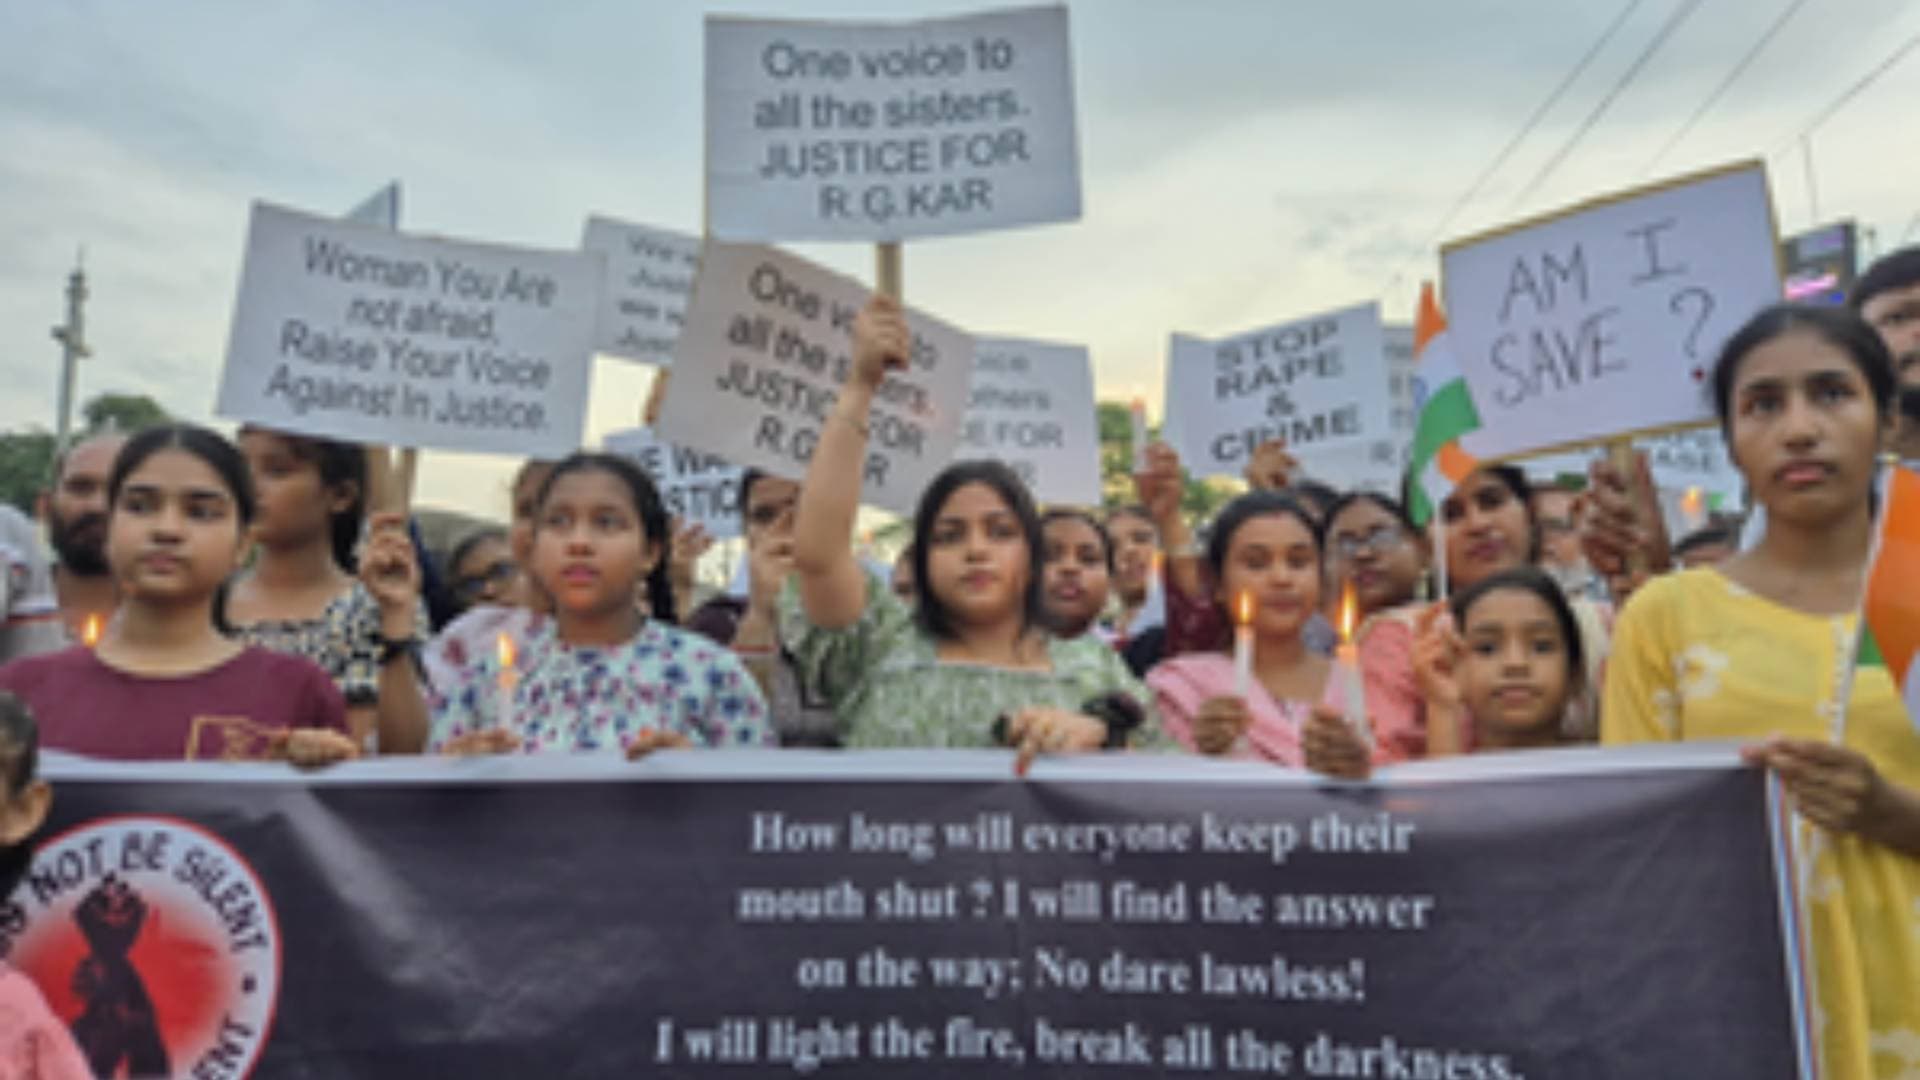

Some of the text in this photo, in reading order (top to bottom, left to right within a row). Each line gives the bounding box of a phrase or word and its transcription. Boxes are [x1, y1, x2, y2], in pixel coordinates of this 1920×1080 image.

[762, 36, 1014, 80] One voice to
[754, 87, 1031, 130] all the sisters.
[759, 127, 1031, 179] JUSTICE FOR
[305, 235, 558, 307] Woman You Are
[749, 262, 822, 322] One
[1498, 216, 1688, 326] AM I
[347, 295, 402, 328] not
[279, 318, 551, 391] Raise Your Voice
[728, 313, 774, 354] all
[773, 328, 827, 374] the
[1215, 319, 1340, 370] STOP
[1215, 343, 1345, 400] RAPE
[1489, 285, 1718, 411] SAVE ?
[265, 362, 396, 416] Against
[401, 381, 429, 418] In
[716, 360, 838, 424] JUSTIC
[1266, 390, 1296, 418] &
[751, 811, 1416, 866] How long will everyone keep their
[29, 831, 271, 954] NOT BE SILENT
[737, 877, 1436, 930] mouth shut ? I will find the answer
[798, 956, 848, 989] on
[857, 946, 921, 989] the
[1034, 946, 1091, 992] No
[1100, 950, 1192, 994] dare
[1201, 953, 1367, 1003] lawless!
[655, 1015, 1527, 1080] I will light the fire, break all the darkness.
